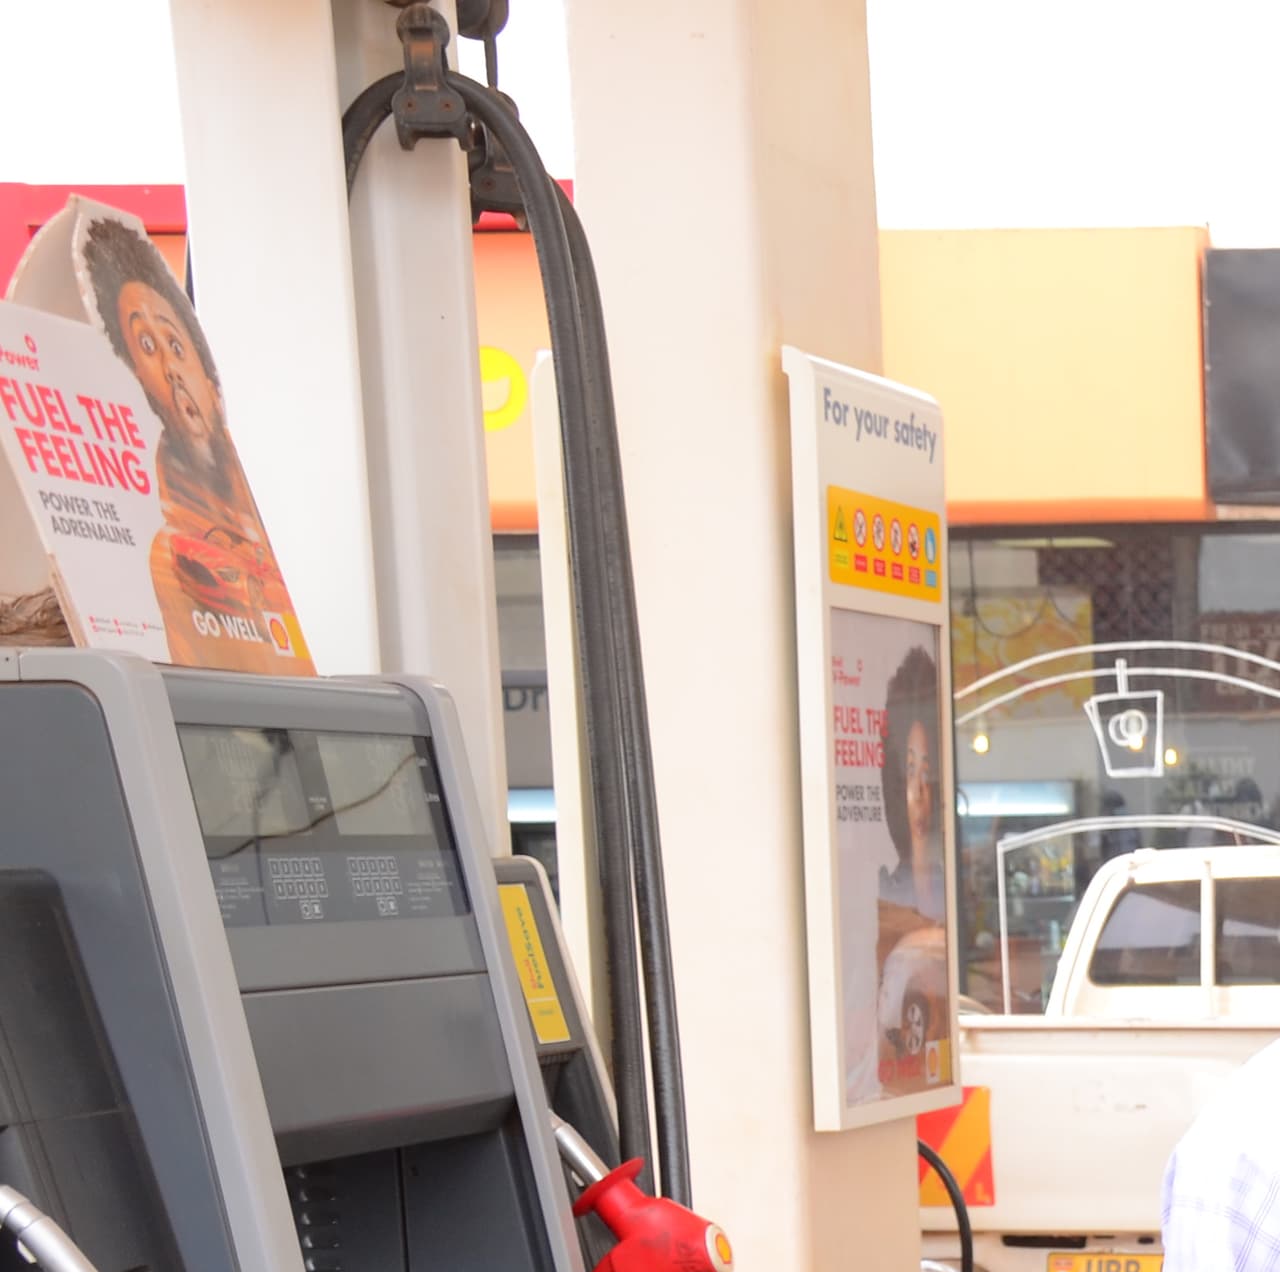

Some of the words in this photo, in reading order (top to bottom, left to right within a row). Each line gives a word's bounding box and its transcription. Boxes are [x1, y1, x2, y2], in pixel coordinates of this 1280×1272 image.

[0, 376, 84, 435] FUEL
[76, 394, 147, 449] THE
[823, 387, 849, 426] For
[855, 399, 890, 441] your
[894, 412, 937, 464] safety
[14, 426, 152, 495] FEELING
[38, 489, 94, 517] POWER
[91, 500, 120, 523] THE
[50, 515, 136, 547] ADRENALINE
[192, 609, 221, 638] GO
[219, 613, 264, 643] WELL
[833, 704, 863, 734] FUEL
[865, 707, 889, 738] THE
[834, 738, 886, 768] FEELING
[836, 784, 864, 801] POWER
[867, 785, 880, 801] THE
[836, 804, 882, 823] ADVENTURE
